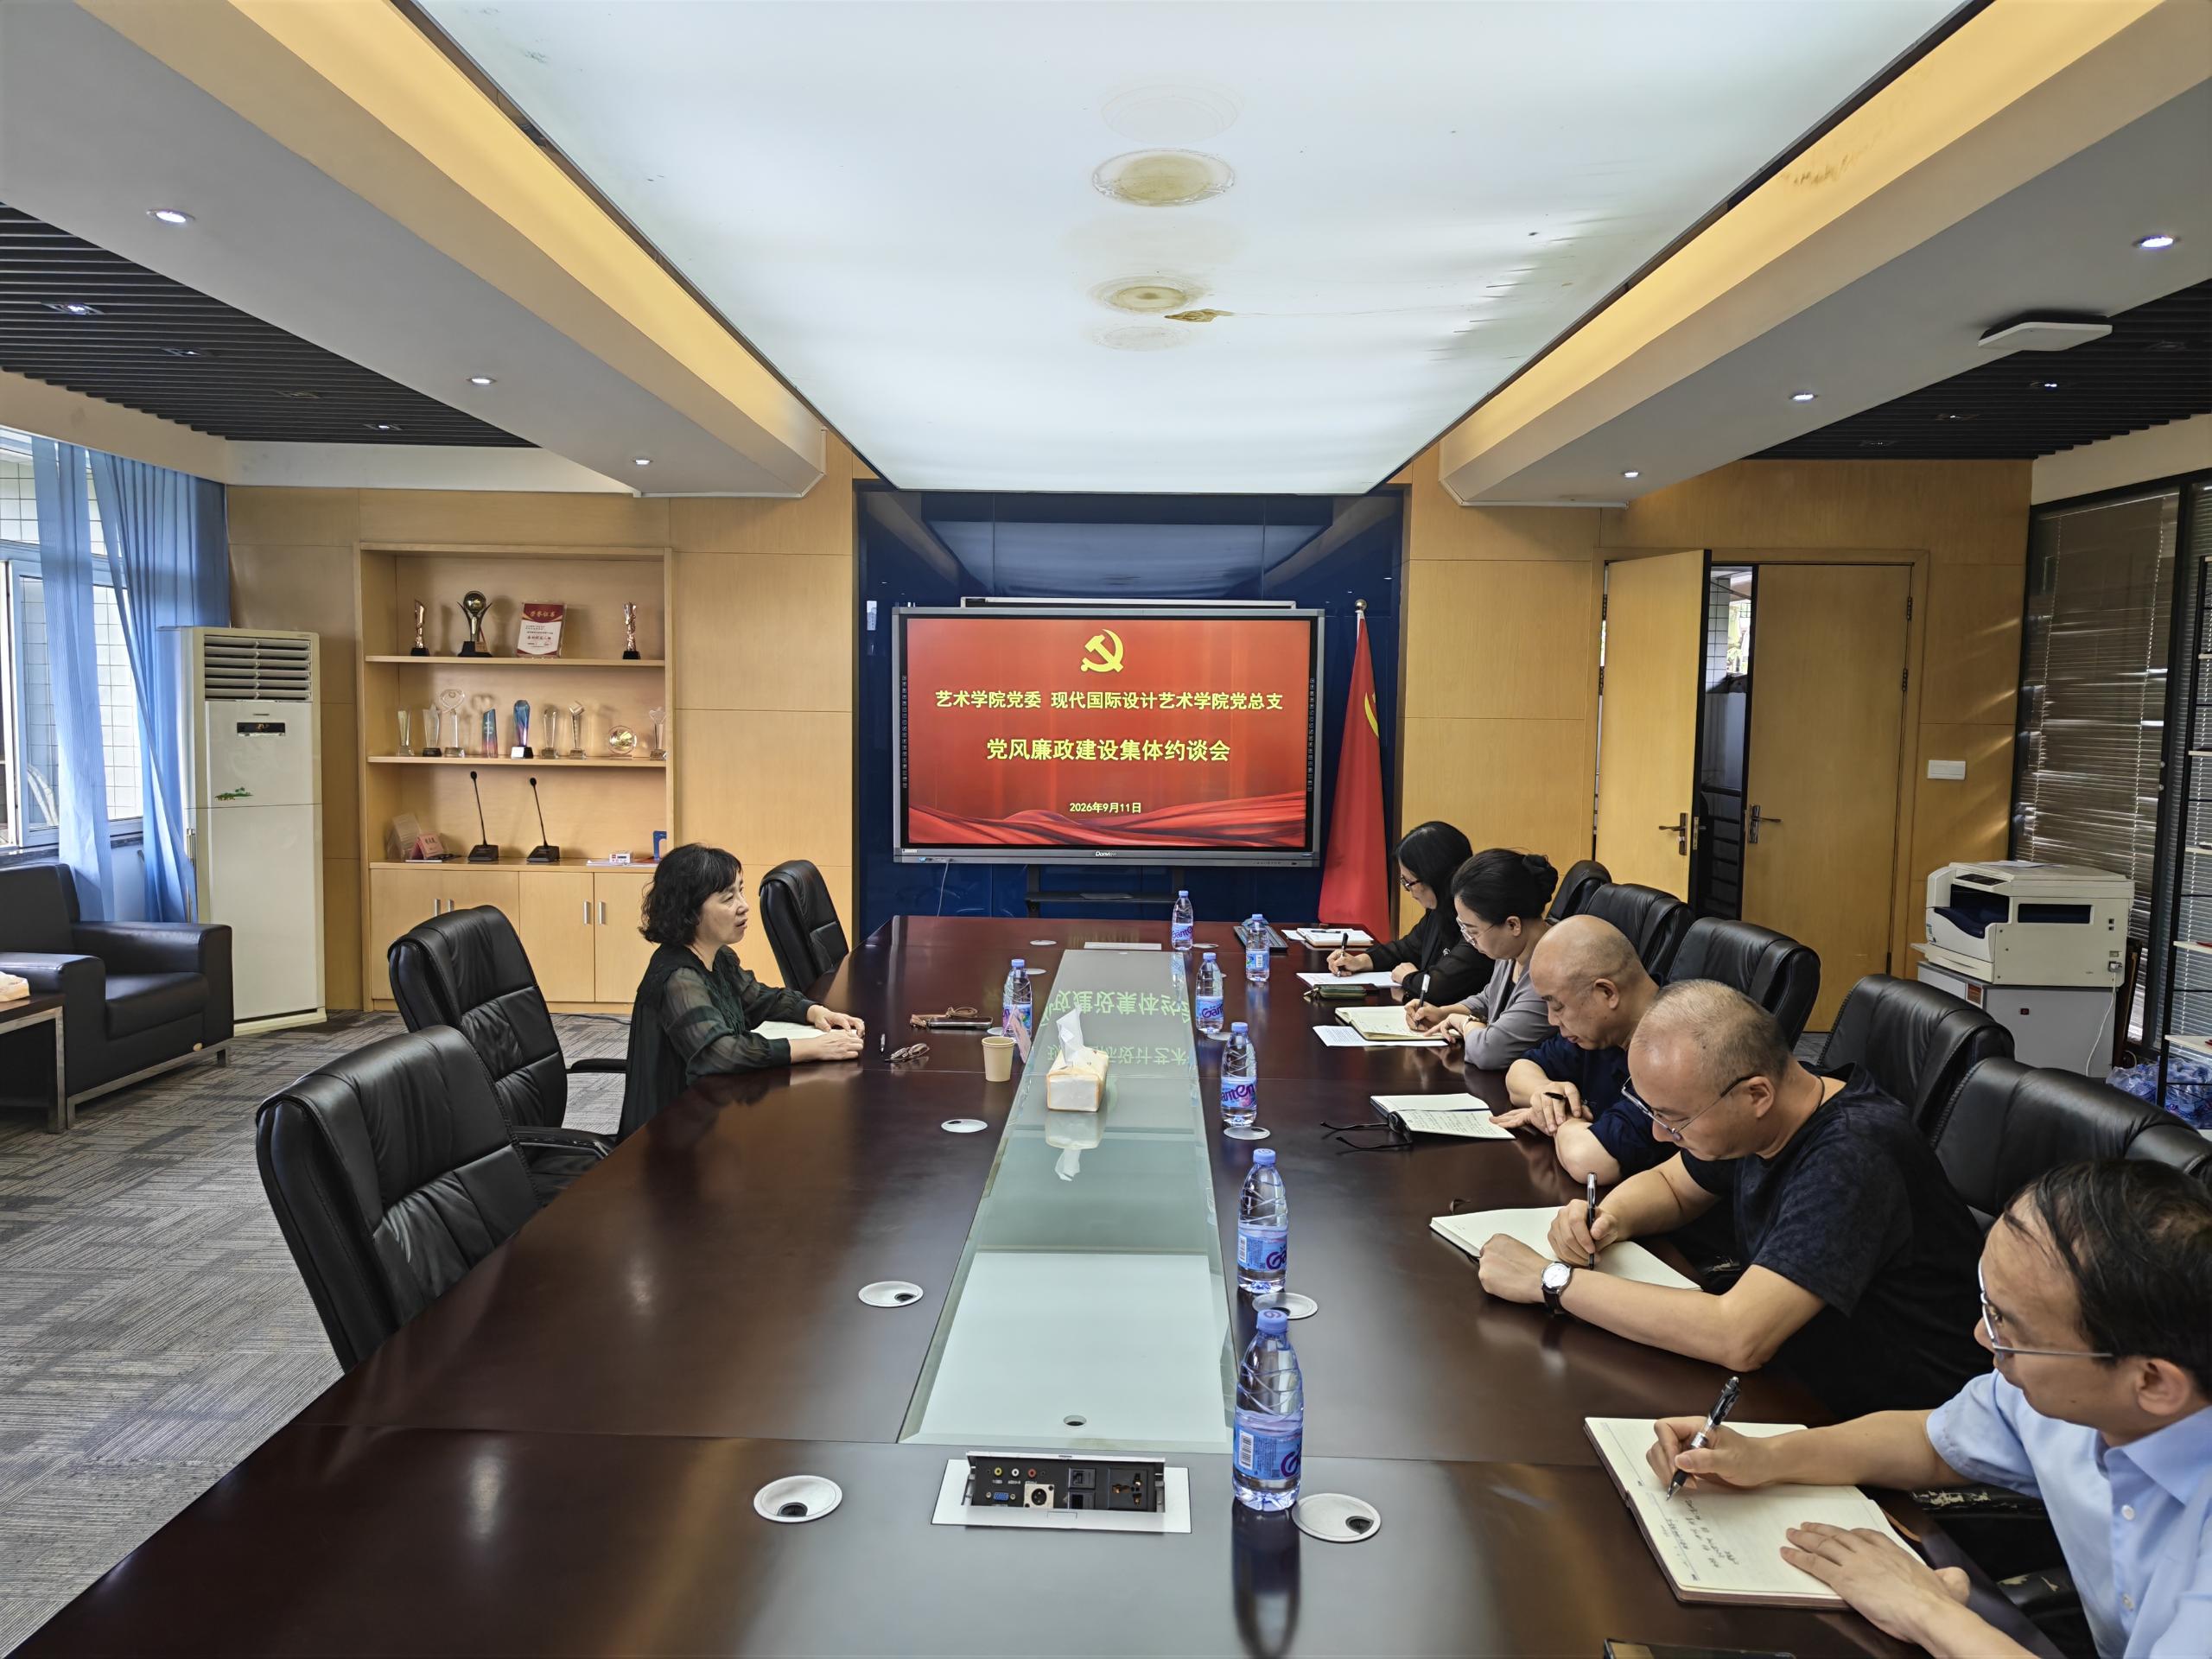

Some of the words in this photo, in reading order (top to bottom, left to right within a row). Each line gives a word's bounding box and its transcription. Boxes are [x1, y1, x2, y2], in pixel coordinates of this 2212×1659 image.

[935, 690, 1041, 709] 艺术学院党委
[1051, 690, 1283, 710] 现代国际设计艺术学院党总支
[987, 738, 1230, 762] 党风廉政建设集体约谈会
[1070, 801, 1141, 813] 2026年9月11日
